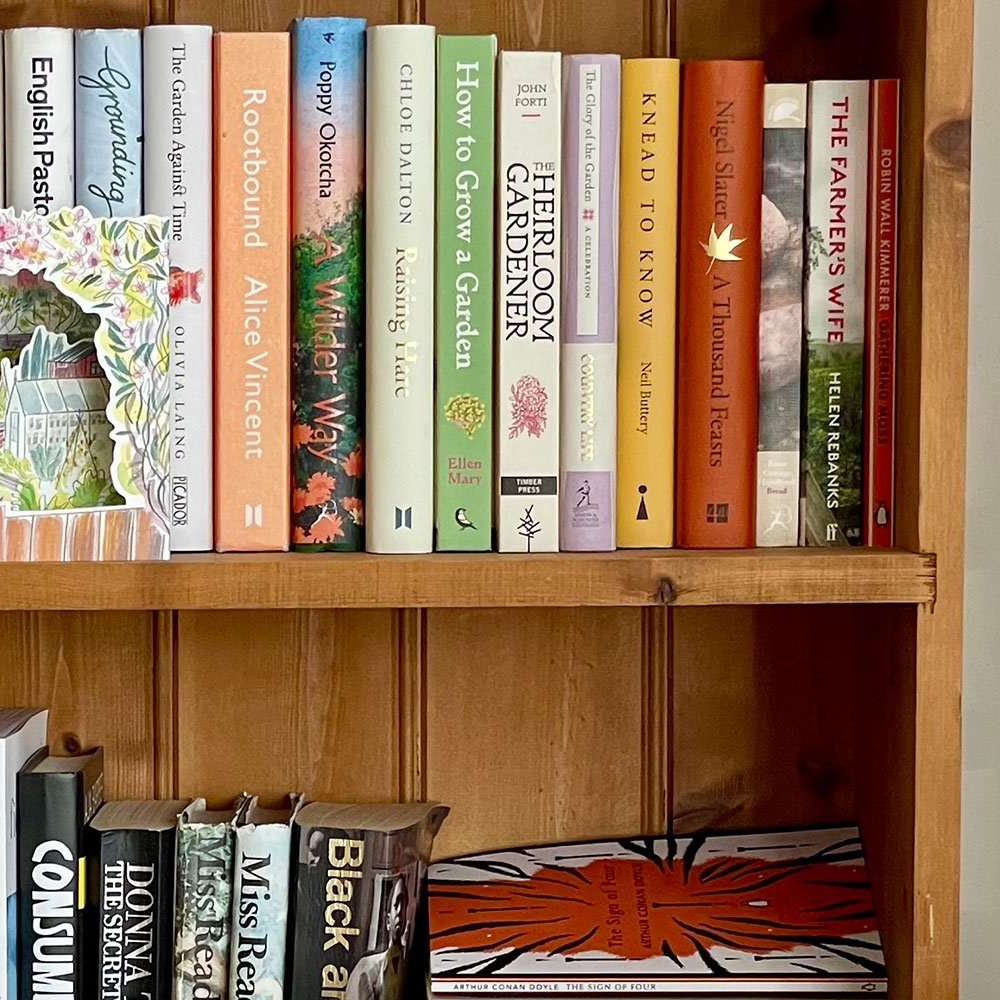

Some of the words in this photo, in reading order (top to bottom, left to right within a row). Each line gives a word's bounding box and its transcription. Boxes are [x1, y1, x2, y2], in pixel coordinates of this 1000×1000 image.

[172, 44, 186, 74] The
[317, 61, 335, 116] Poppy
[29, 58, 52, 146] English
[172, 80, 186, 136] Garden
[399, 64, 413, 134] CHLOE
[454, 61, 478, 128] How
[713, 100, 734, 154] Nigel
[832, 97, 849, 147] THE
[171, 141, 187, 196] Against
[243, 89, 265, 248] Rootbound
[318, 123, 336, 198] Okotcha
[641, 93, 656, 182] KNEAD
[880, 149, 892, 194] ROBIN
[399, 142, 413, 224] DALTON
[455, 170, 478, 244] Grow
[640, 200, 655, 233] TO
[714, 161, 733, 220] Slater
[829, 157, 848, 275] FARMER'S
[880, 198, 891, 235] WALL
[173, 202, 186, 241] Time
[505, 163, 528, 341] GARDENER
[532, 174, 554, 342] HEIRLOOM
[639, 251, 654, 328] KNOW
[878, 239, 891, 312] KIMMERER
[244, 276, 267, 345] Alice
[313, 276, 345, 378] Wilder
[455, 273, 478, 369] Garden
[828, 288, 845, 342] WIFE
[175, 327, 186, 391] OLIVIA
[640, 362, 652, 386] Neil
[710, 299, 730, 399] Thousand
[175, 402, 186, 460] LAING
[245, 352, 266, 459] Vincent
[308, 396, 345, 464] Way
[637, 391, 652, 435] Buttery
[828, 372, 841, 426] HELEN
[710, 407, 728, 467] Feasts
[827, 433, 840, 509] REBANKS
[172, 477, 188, 526] PICADOR
[104, 861, 123, 909] THE
[239, 854, 270, 928] Miss
[323, 839, 363, 950] Black
[122, 863, 155, 980] DONNA
